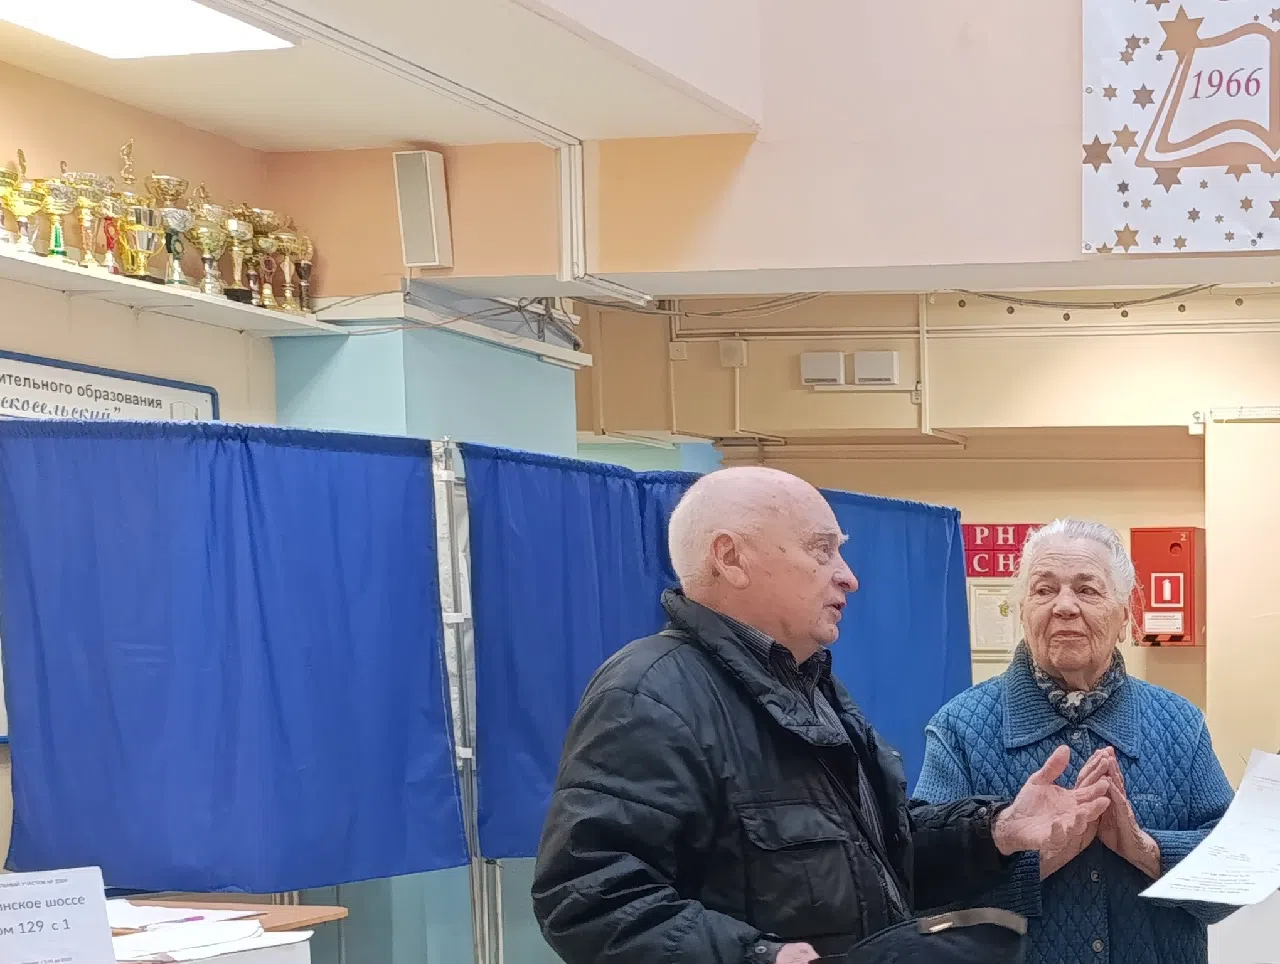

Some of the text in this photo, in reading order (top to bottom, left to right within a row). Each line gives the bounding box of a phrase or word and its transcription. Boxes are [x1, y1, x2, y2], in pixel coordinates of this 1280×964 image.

[1189, 67, 1263, 100] 1966
[77, 385, 163, 410] образования
[45, 896, 86, 908] шоссе
[18, 920, 44, 934] 129
[62, 918, 71, 930] 1
